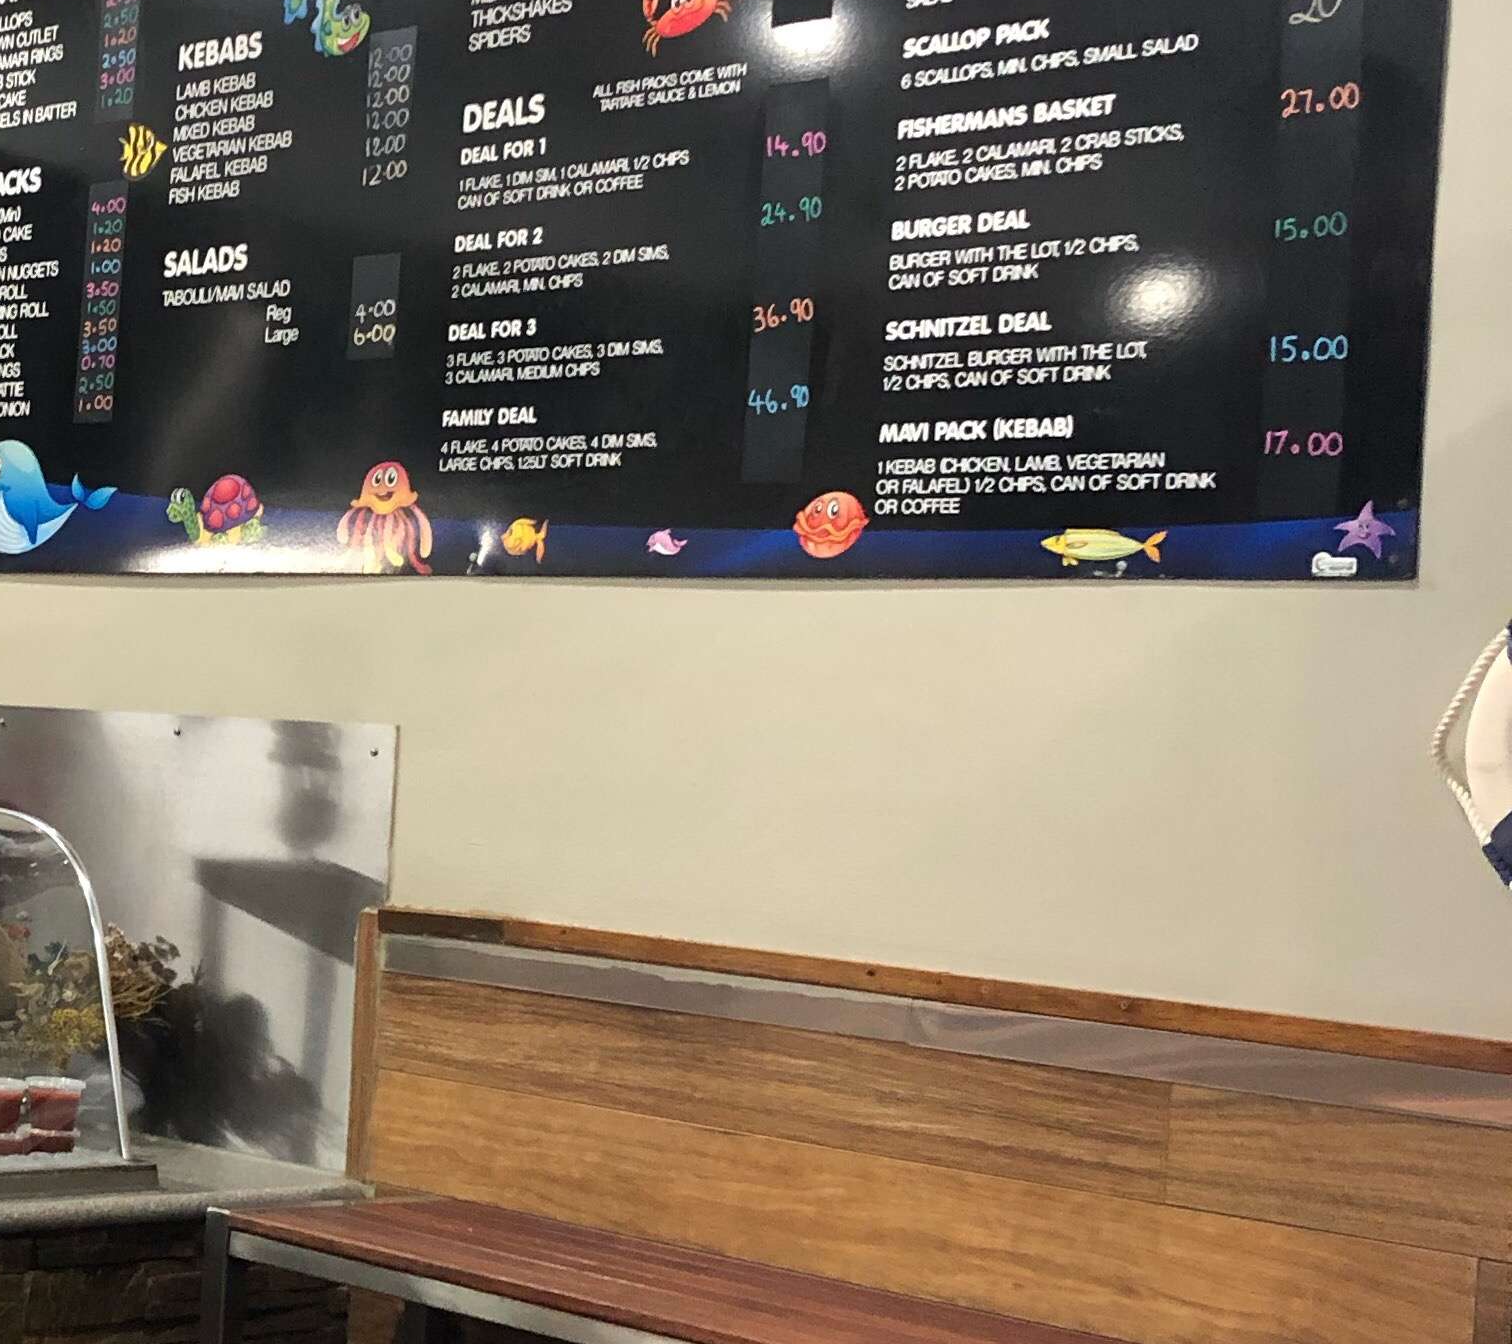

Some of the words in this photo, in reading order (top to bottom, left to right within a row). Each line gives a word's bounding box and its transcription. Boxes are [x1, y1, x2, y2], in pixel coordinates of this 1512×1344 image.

[17, 25, 58, 48] CUTLET
[469, 24, 531, 52] SPIDERS
[903, 26, 989, 58] SCALLOP
[995, 18, 1050, 47] PACK
[31, 45, 63, 66] RINGS
[178, 31, 262, 72] KEBABS
[176, 79, 210, 101] LAMB
[214, 72, 256, 95] KEBAB
[22, 108, 32, 125] IN
[36, 102, 76, 123] BATTER
[175, 97, 227, 121] CHICKEN
[230, 90, 273, 113] KEBAB
[462, 93, 545, 134] DEALS
[898, 104, 1028, 140] FISHERMANS
[1034, 94, 1115, 124] BASKET
[173, 121, 209, 142] MIXED
[213, 115, 255, 137] KEBAB
[173, 137, 246, 162] VEGETARIAN
[249, 131, 292, 152] KEBAB
[461, 143, 499, 166] DEAL
[503, 140, 534, 160] FOR
[538, 138, 546, 156] 1
[170, 161, 221, 184] FALAFEL
[224, 156, 267, 177] KEBAB
[169, 185, 195, 204] FISH
[197, 180, 240, 201] KEBAB
[2, 225, 33, 243] CAKE
[892, 214, 970, 240] BURGER
[977, 210, 1030, 234] DEAL
[455, 232, 493, 252] DEAL
[497, 229, 528, 249] FOR
[532, 227, 543, 245] 2
[7, 262, 59, 282] NUGGETS
[164, 243, 248, 278] SALADS
[247, 280, 290, 299] SALAD
[267, 303, 292, 324] Reg
[886, 315, 991, 342] SCHNITZEL
[999, 311, 1051, 335] DEAL
[265, 325, 300, 346] Large
[448, 323, 486, 342] DEAL
[491, 320, 521, 339] FOR
[526, 319, 536, 336] 3
[442, 409, 493, 427] FAMILY
[498, 407, 536, 425] DEAL
[879, 421, 929, 444] MAVI
[935, 419, 986, 442] PACK
[993, 416, 1073, 440] (KEBAB)
[875, 496, 898, 514] OR
[901, 496, 960, 514] COFFEE
